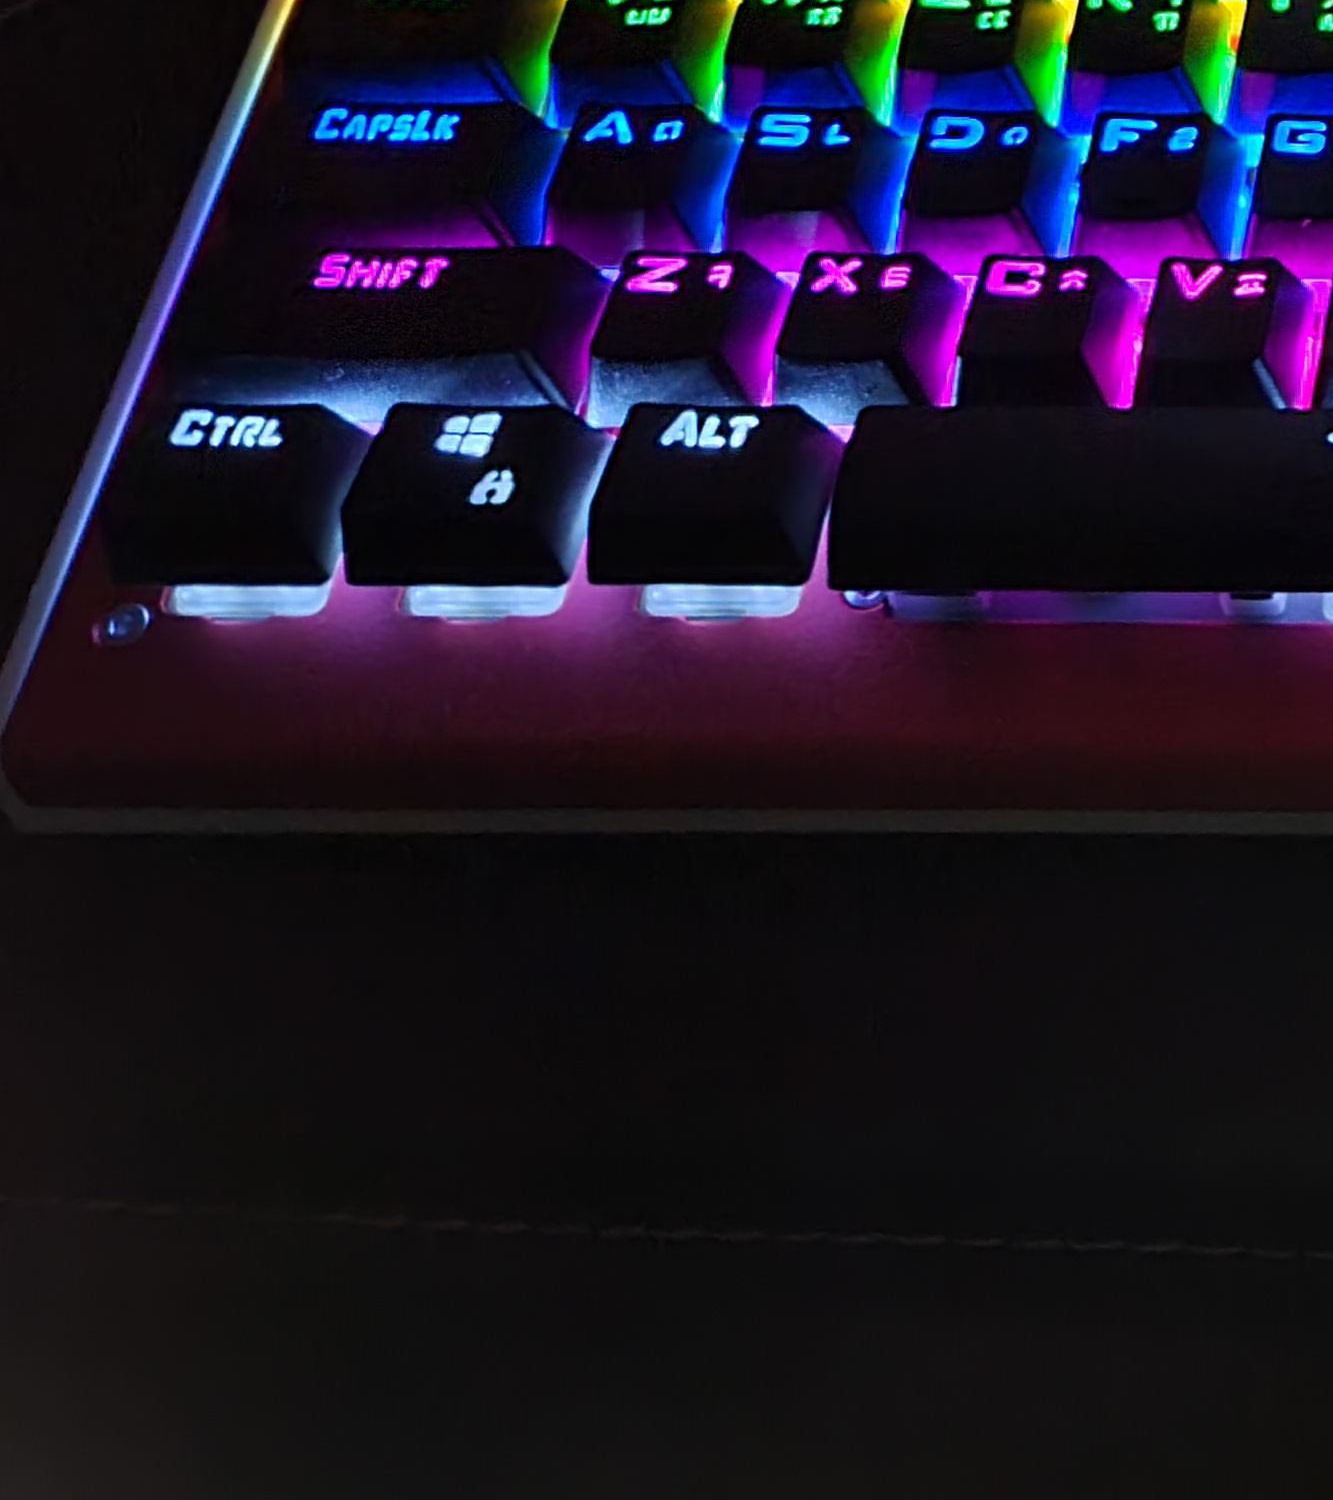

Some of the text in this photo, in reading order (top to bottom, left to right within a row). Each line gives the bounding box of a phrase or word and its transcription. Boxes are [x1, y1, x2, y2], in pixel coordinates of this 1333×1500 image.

[582, 111, 635, 142] A
[756, 112, 814, 148] S
[929, 115, 984, 150] D
[1100, 119, 1156, 152] F
[1272, 122, 1328, 154] G
[626, 258, 688, 291] Z
[810, 259, 861, 292] X
[985, 261, 1045, 296] C
[1170, 262, 1225, 299] V
